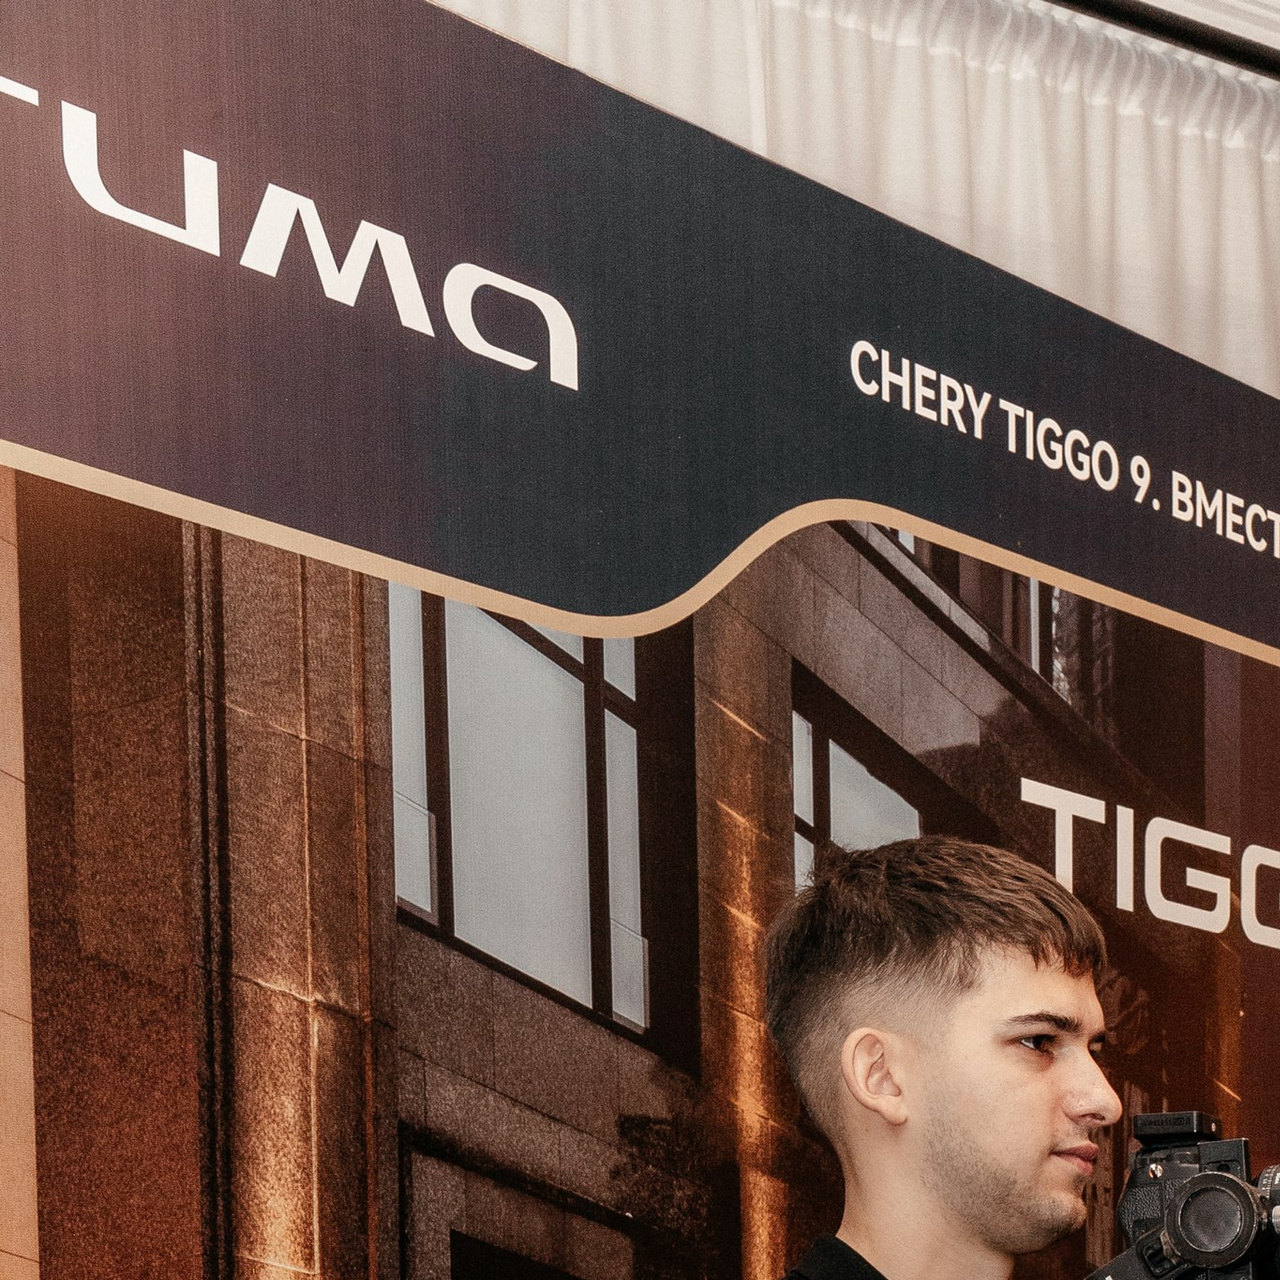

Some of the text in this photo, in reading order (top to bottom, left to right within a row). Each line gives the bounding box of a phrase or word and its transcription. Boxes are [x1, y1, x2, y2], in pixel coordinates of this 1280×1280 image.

[850, 340, 992, 440] CHERY
[999, 398, 1119, 491] TIGGO
[1130, 455, 1161, 511] 9.
